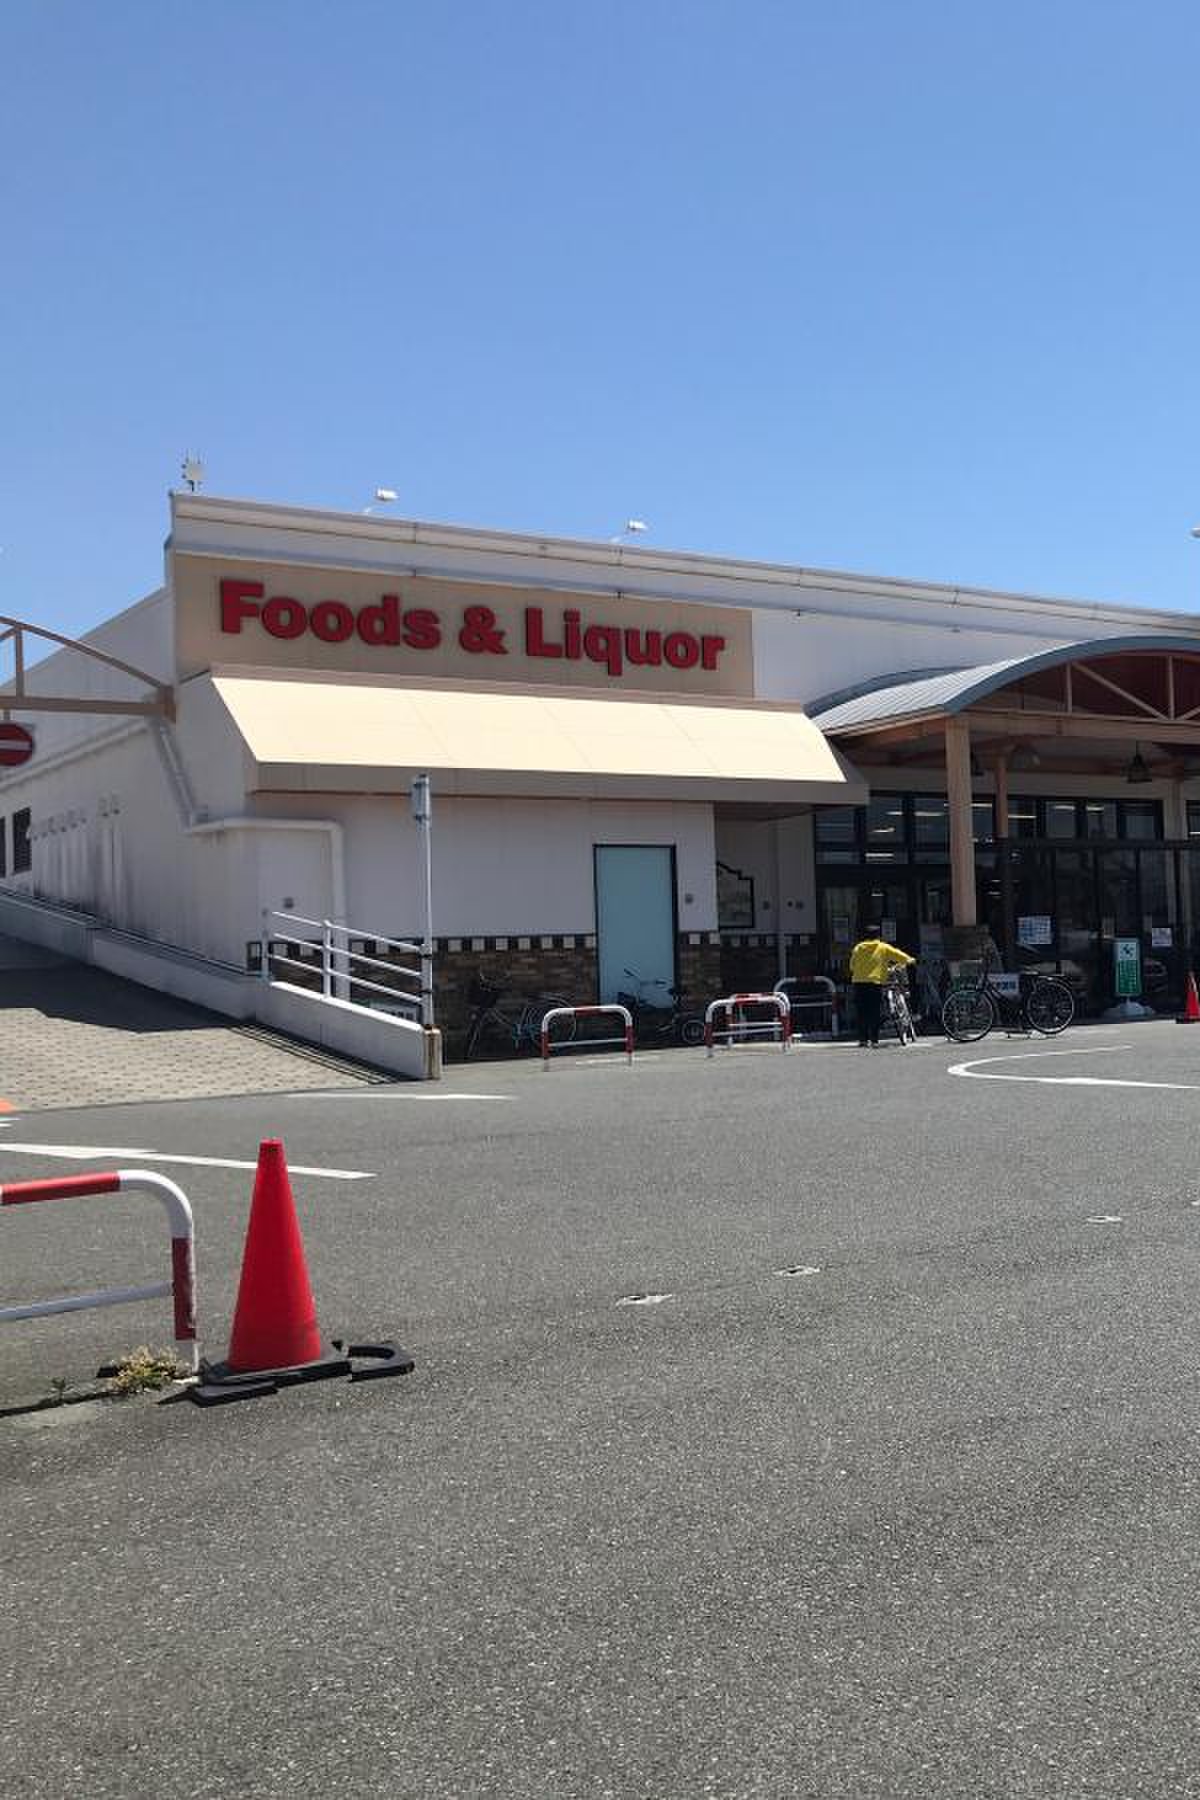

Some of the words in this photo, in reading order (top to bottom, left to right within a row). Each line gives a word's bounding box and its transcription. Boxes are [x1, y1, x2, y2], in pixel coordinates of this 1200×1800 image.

[219, 578, 443, 651] Foods
[458, 604, 508, 656] &
[524, 605, 727, 677] Liquor
